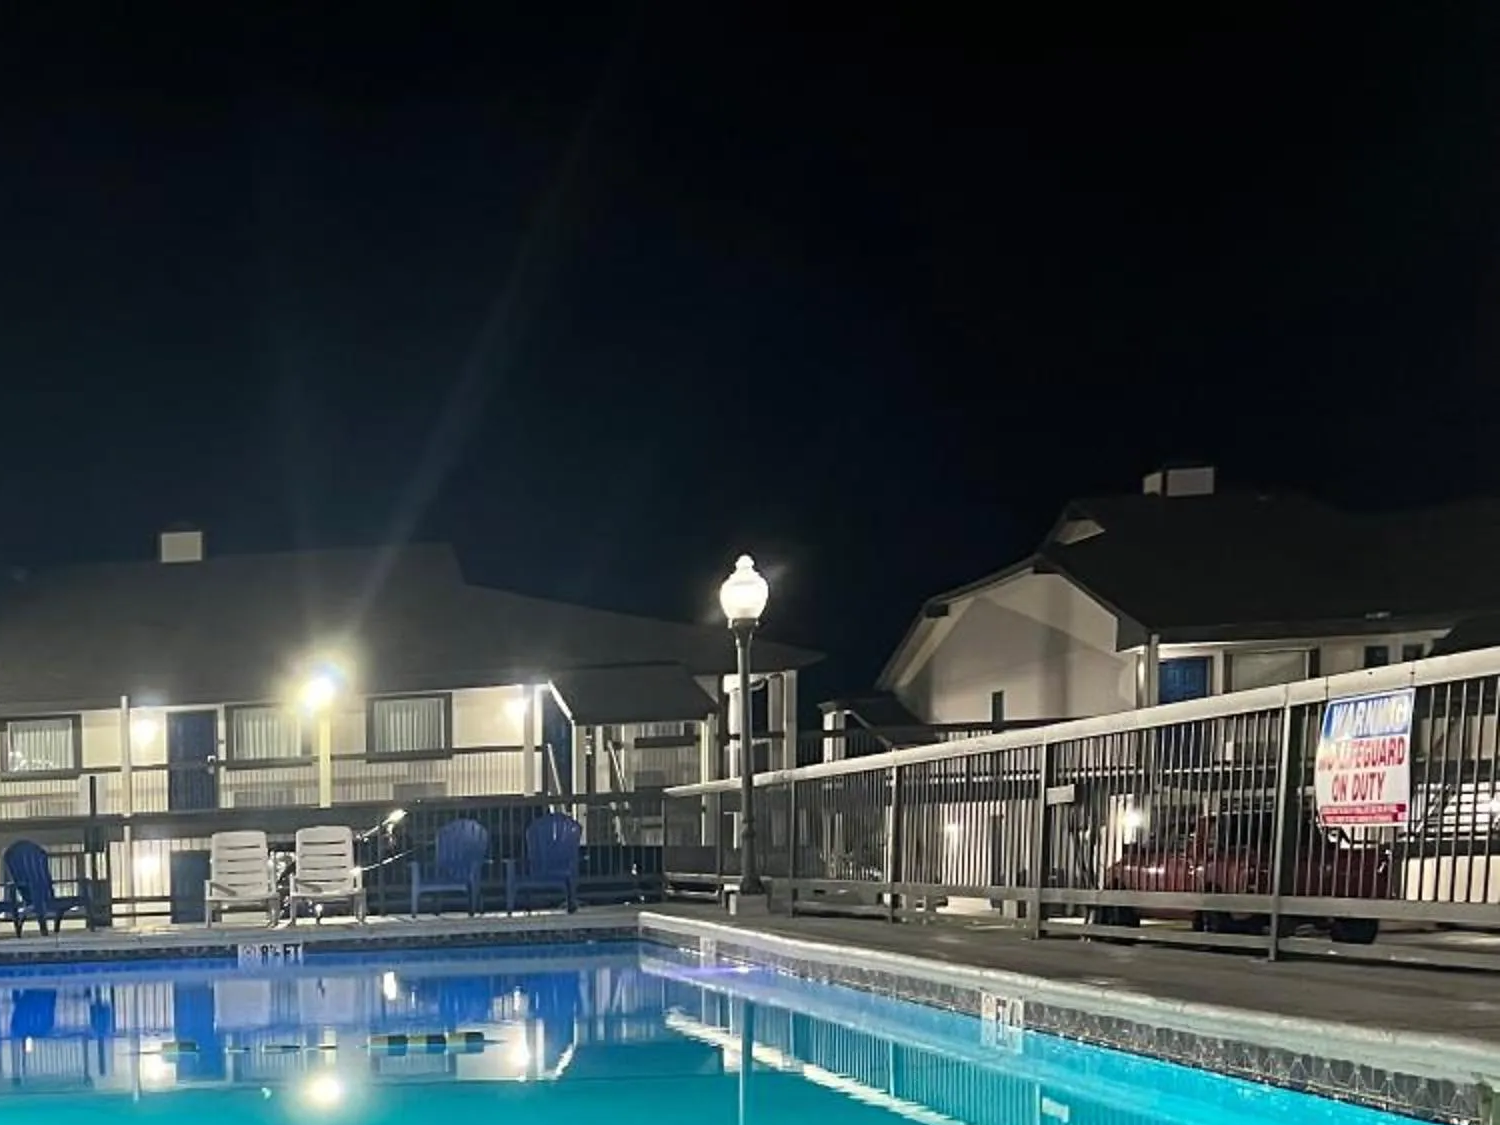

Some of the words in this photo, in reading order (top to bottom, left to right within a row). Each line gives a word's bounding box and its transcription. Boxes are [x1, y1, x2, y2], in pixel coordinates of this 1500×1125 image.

[1331, 696, 1408, 737] WARNING
[1332, 774, 1347, 802] ON
[1351, 771, 1386, 801] DUTY
[283, 943, 301, 958] FT
